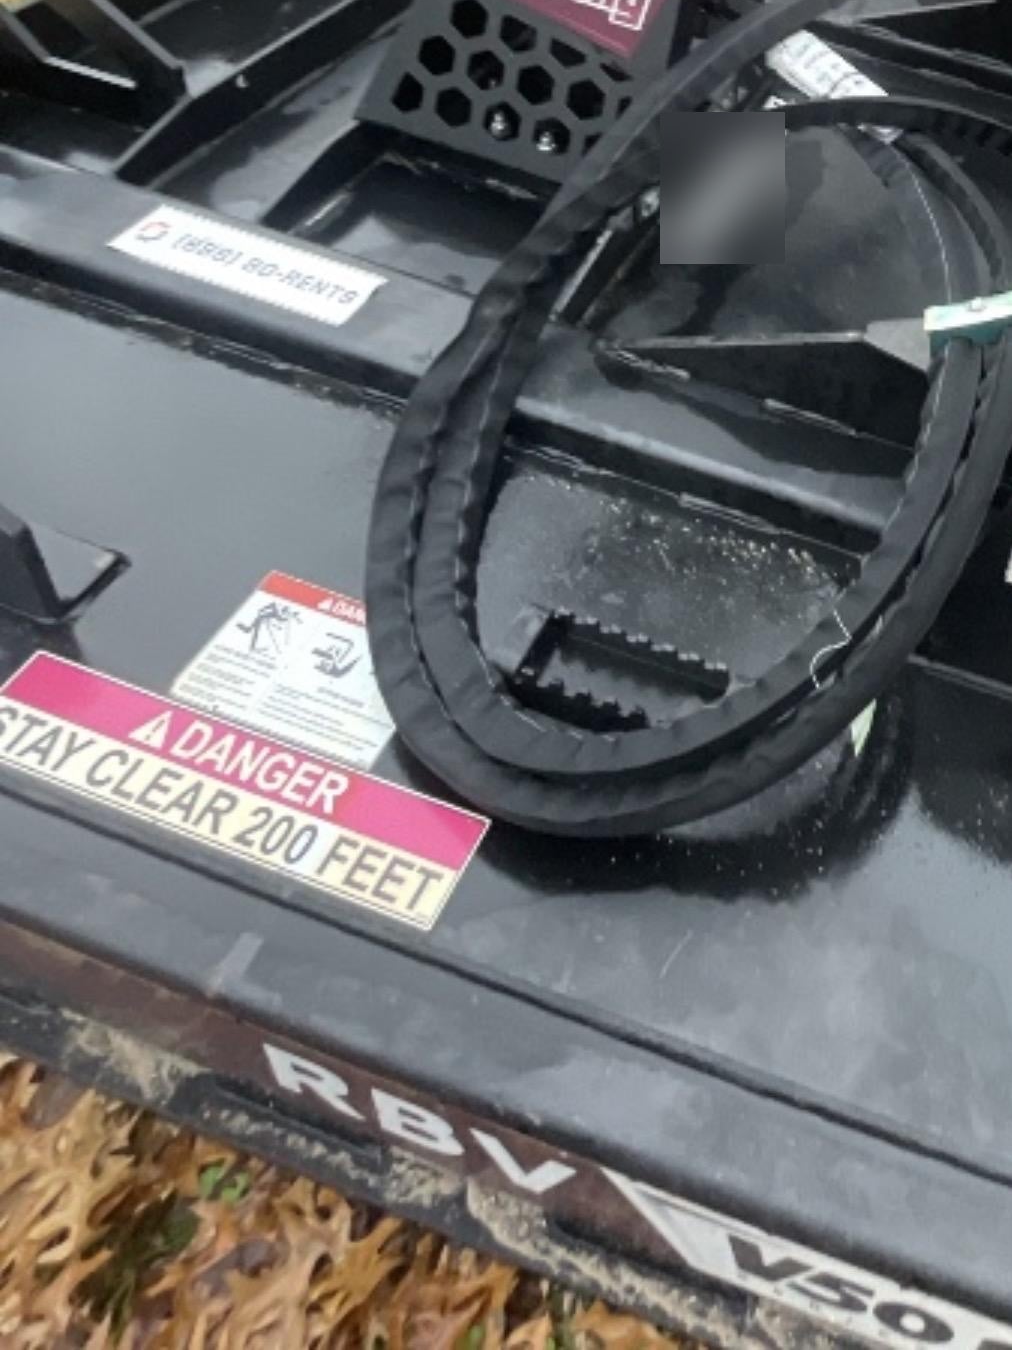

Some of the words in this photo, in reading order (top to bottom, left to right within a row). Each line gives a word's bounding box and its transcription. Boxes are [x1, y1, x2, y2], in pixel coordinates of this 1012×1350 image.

[85, 748, 239, 834] CLEAR
[234, 806, 319, 866] 200
[315, 835, 444, 911] FEET
[171, 719, 350, 814] DANGER
[261, 1043, 577, 1194] RBV
[728, 1233, 955, 1343] V50
